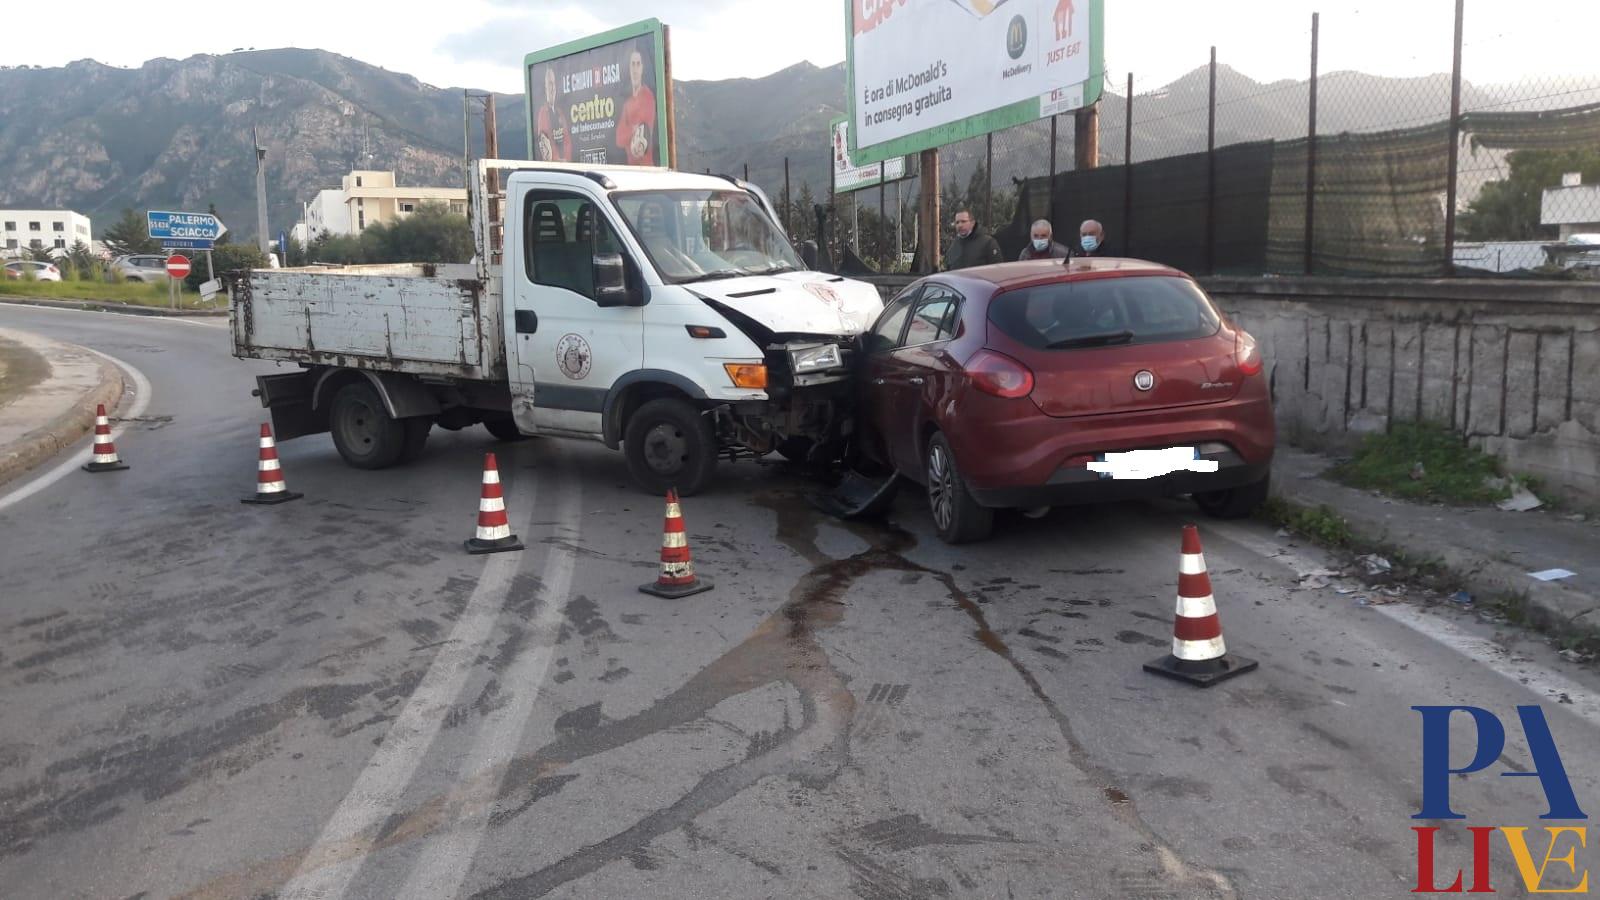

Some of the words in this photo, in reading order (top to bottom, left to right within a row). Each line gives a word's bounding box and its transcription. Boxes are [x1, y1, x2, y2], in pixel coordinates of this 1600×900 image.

[1046, 47, 1065, 66] JUST
[1066, 41, 1081, 58] EAT
[563, 74, 570, 93] LE
[571, 69, 592, 91] CHIAVI
[602, 64, 620, 84] CASA
[864, 85, 870, 104] È
[871, 87, 884, 102] ora
[886, 79, 893, 97] di
[895, 59, 947, 94] McDonald's
[1003, 64, 1032, 80] McDelivery
[571, 95, 614, 123] centro
[865, 111, 872, 127] in
[874, 102, 912, 122] consegna
[915, 85, 952, 116] gratuita
[169, 215, 214, 225] PALERMO
[171, 227, 215, 237] SCIACCA
